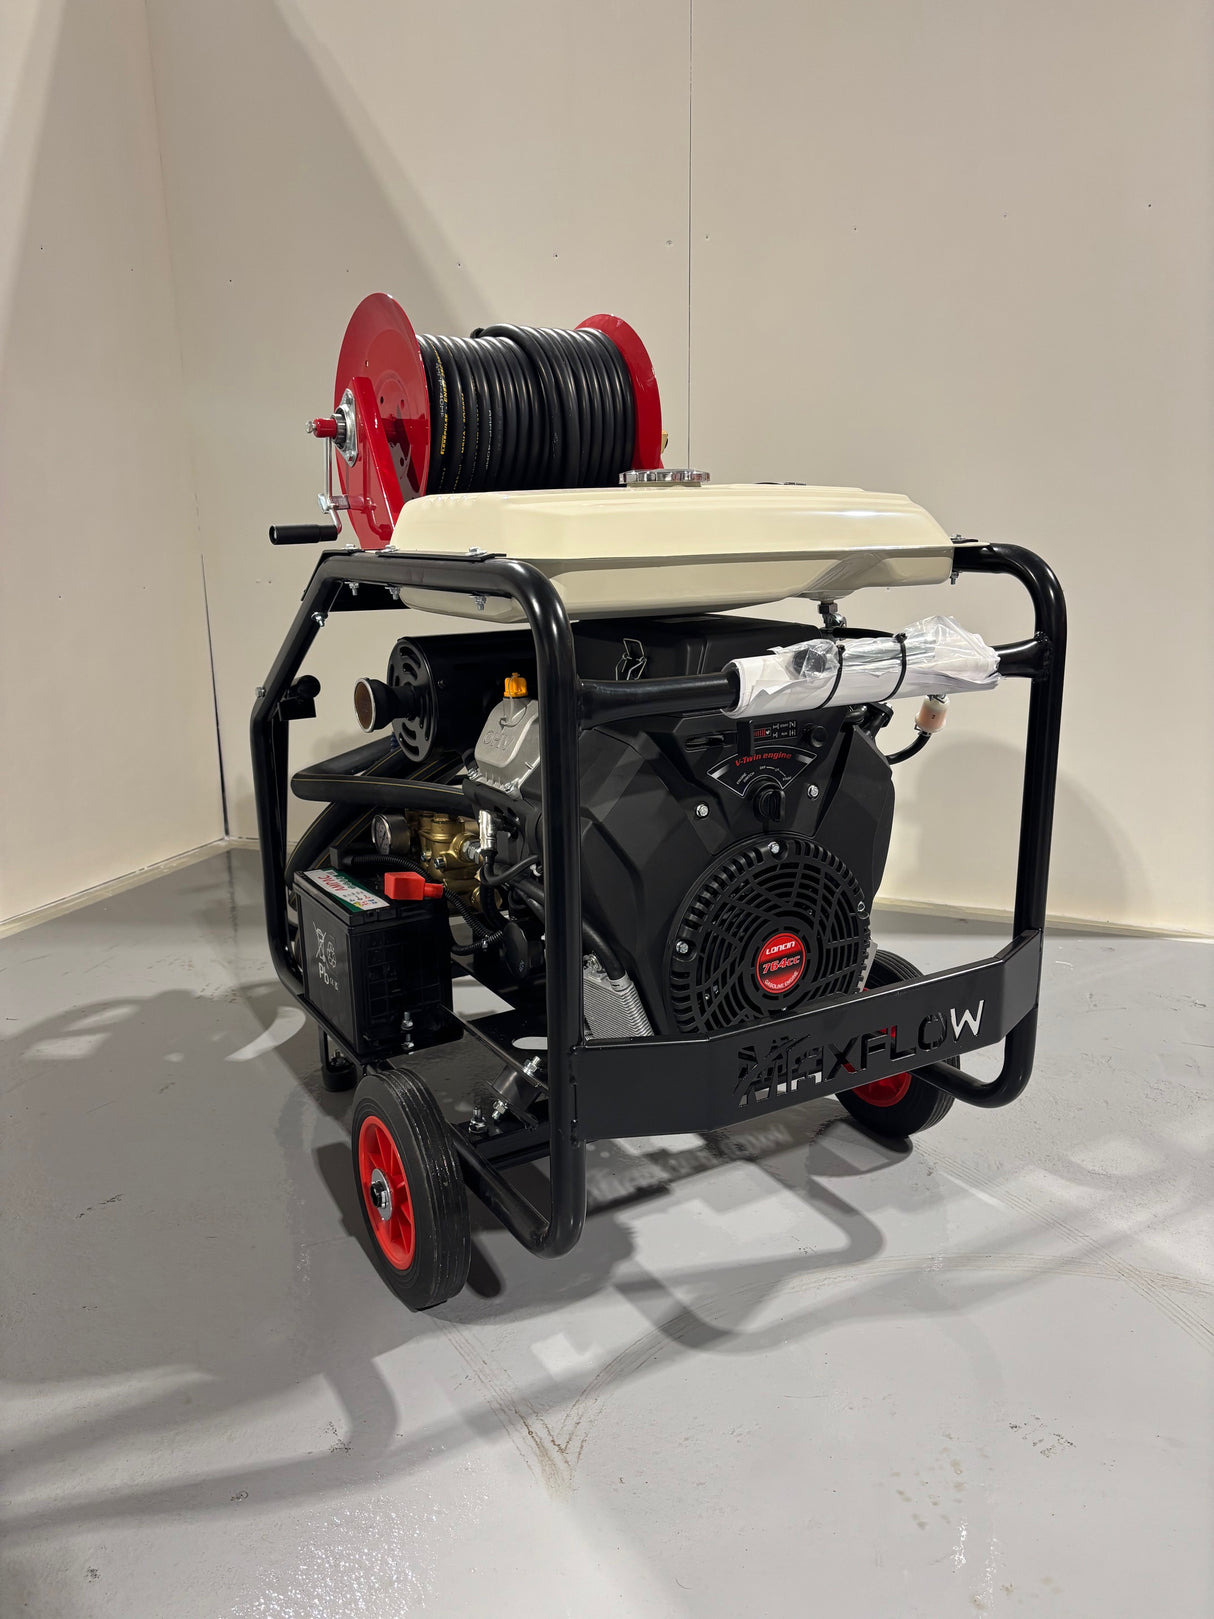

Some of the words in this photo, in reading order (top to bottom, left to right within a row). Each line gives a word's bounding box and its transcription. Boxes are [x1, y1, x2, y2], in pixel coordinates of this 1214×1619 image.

[735, 752, 761, 767] V-Twin
[762, 751, 792, 760] engine
[318, 962, 330, 985] Pb
[763, 956, 800, 974] 764cc
[732, 1000, 985, 1108] MAXFLOW
